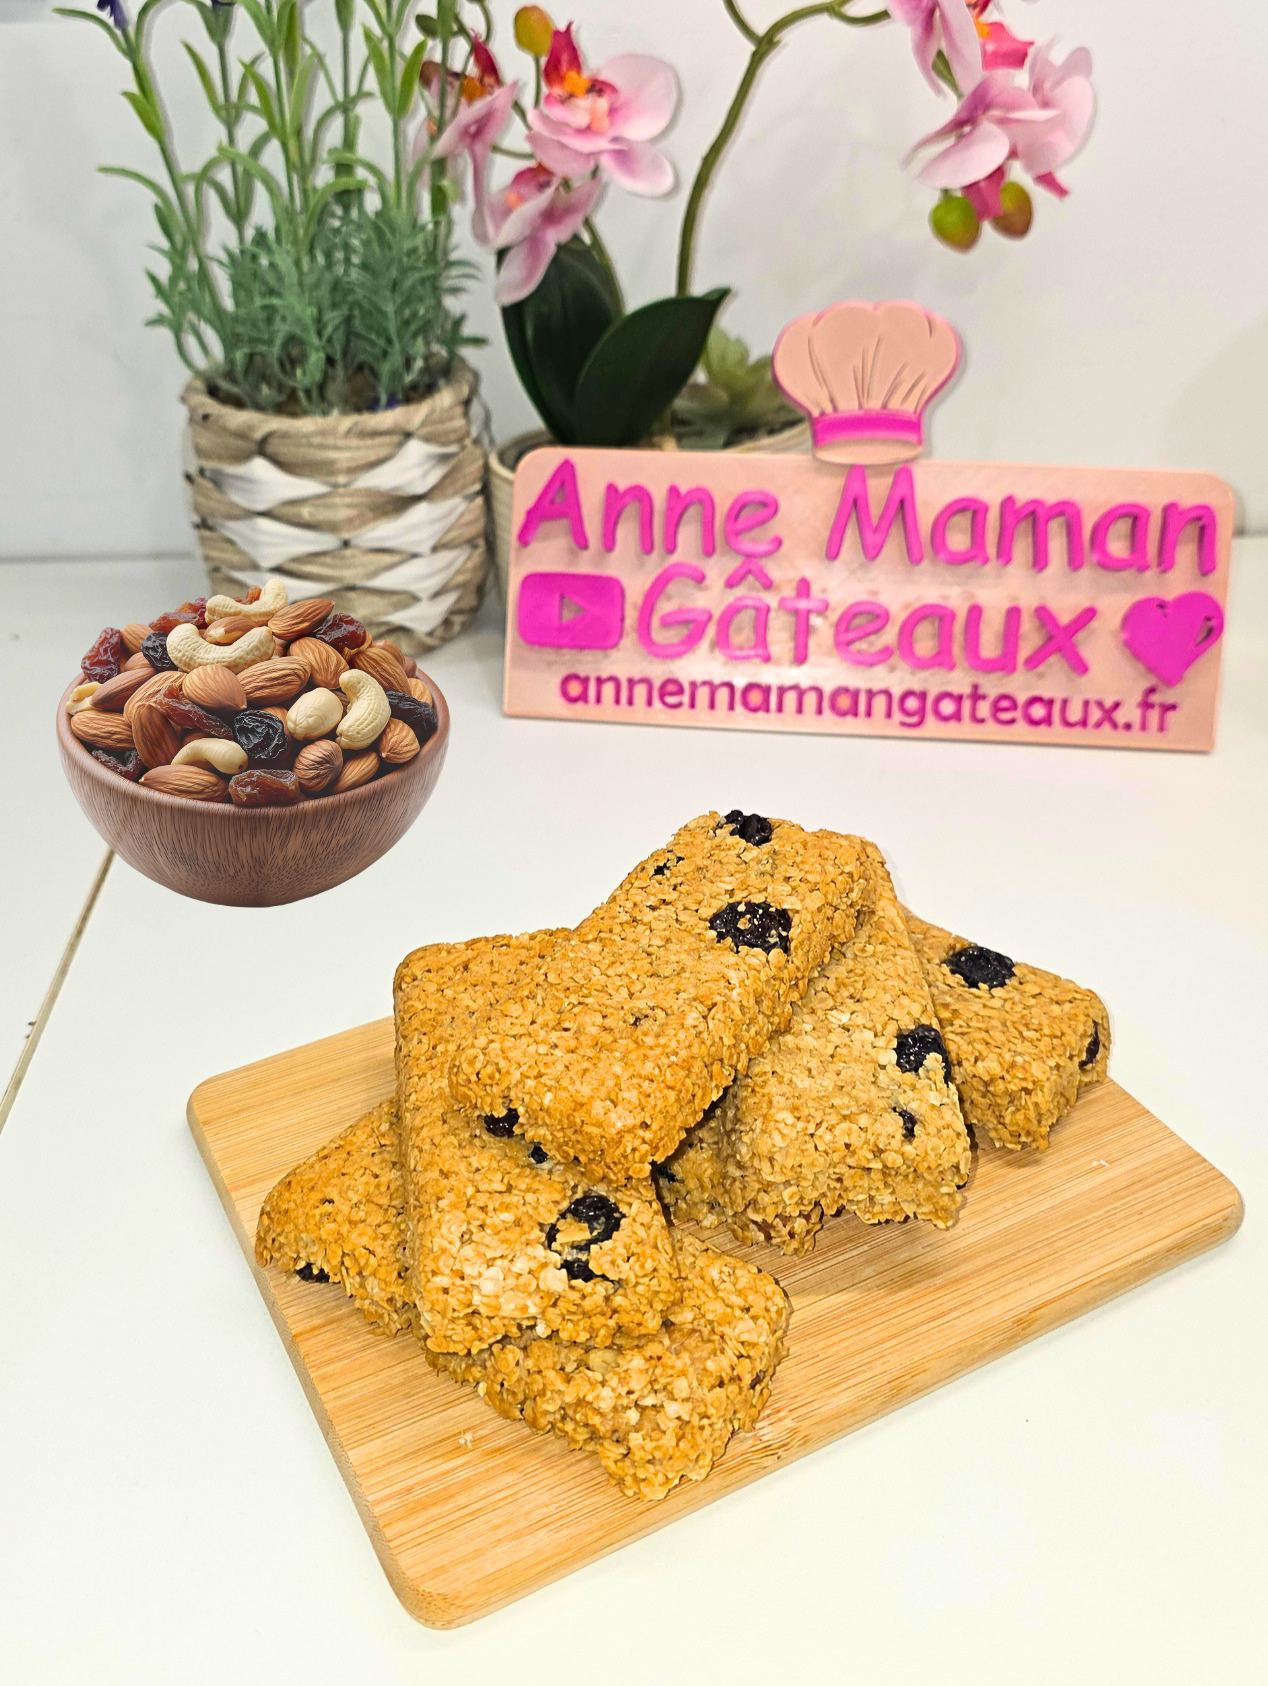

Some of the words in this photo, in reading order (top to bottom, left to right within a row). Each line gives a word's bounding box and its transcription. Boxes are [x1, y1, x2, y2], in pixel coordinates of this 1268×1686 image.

[517, 459, 783, 557] Anne
[825, 464, 1218, 575] Maman
[637, 557, 1098, 676] Gâteaux
[560, 671, 1178, 734] annemamangateaux.fr
